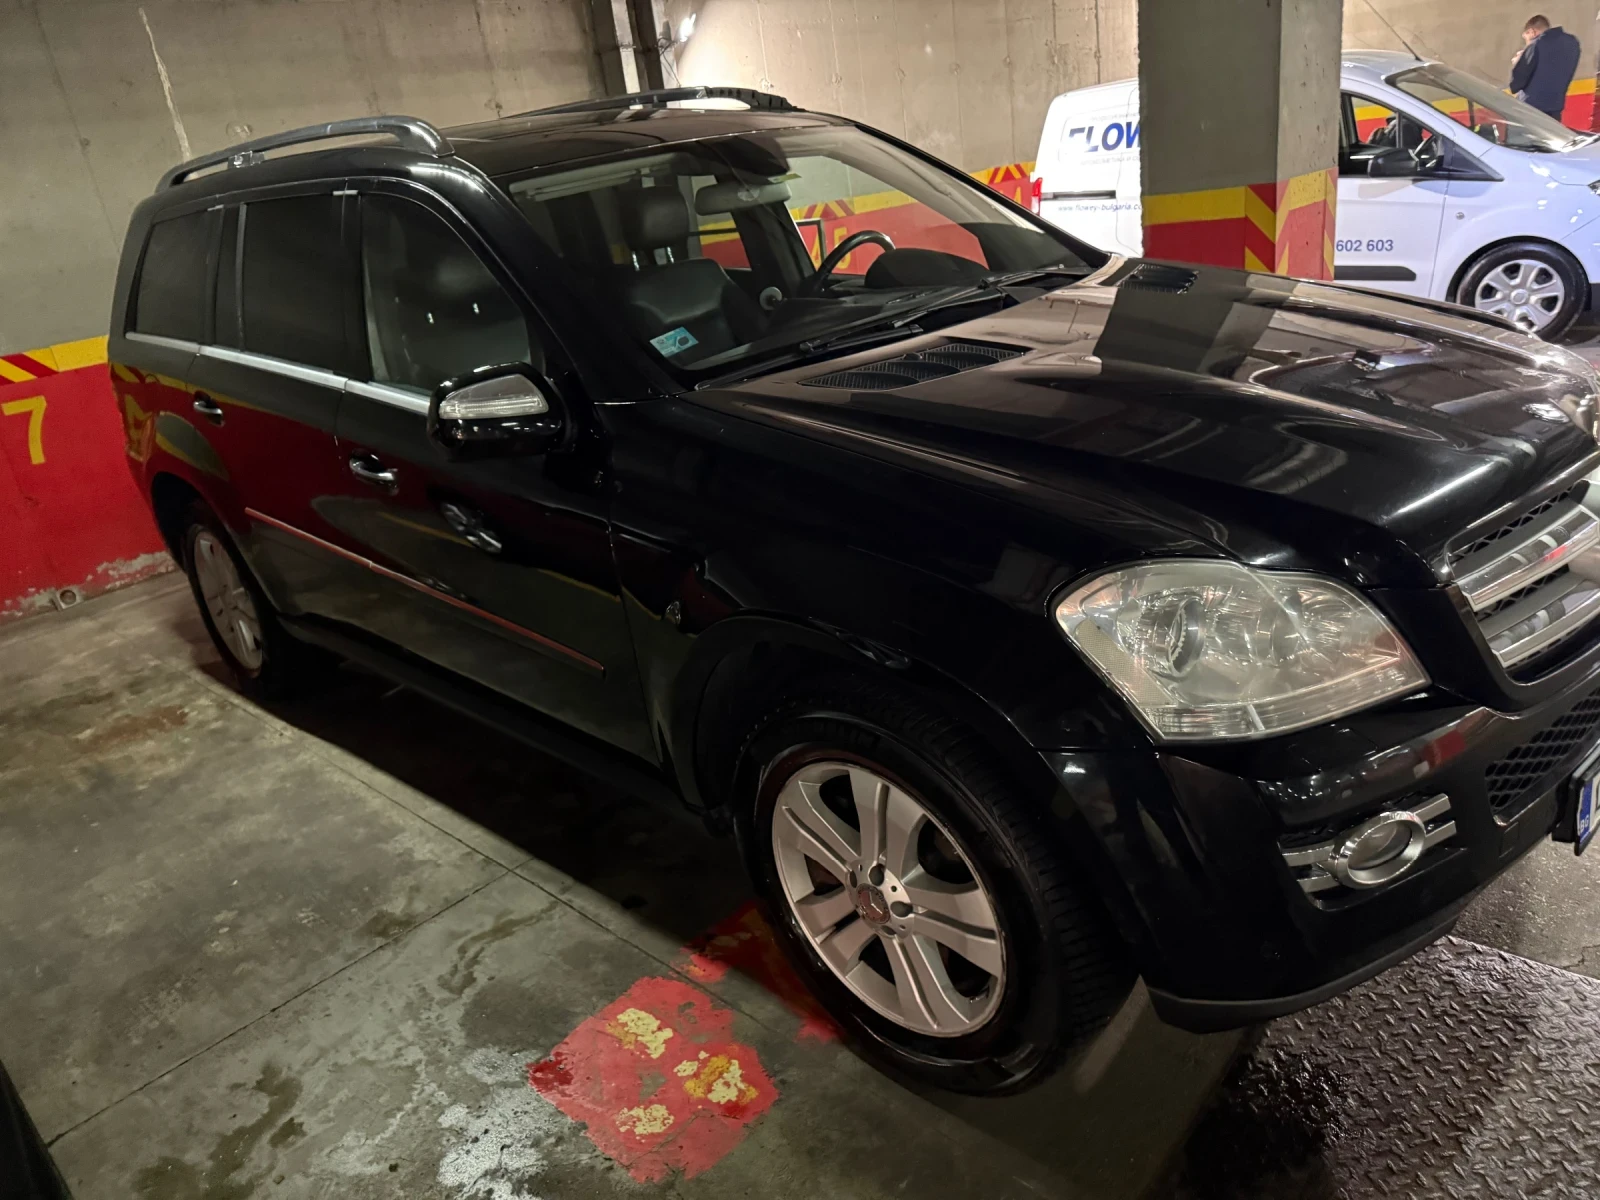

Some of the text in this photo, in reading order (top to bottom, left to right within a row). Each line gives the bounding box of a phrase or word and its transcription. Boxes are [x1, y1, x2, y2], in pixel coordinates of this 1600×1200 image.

[1336, 239, 1394, 252] 602 603
[1, 395, 47, 465] 7
[1580, 814, 1590, 834] BG
